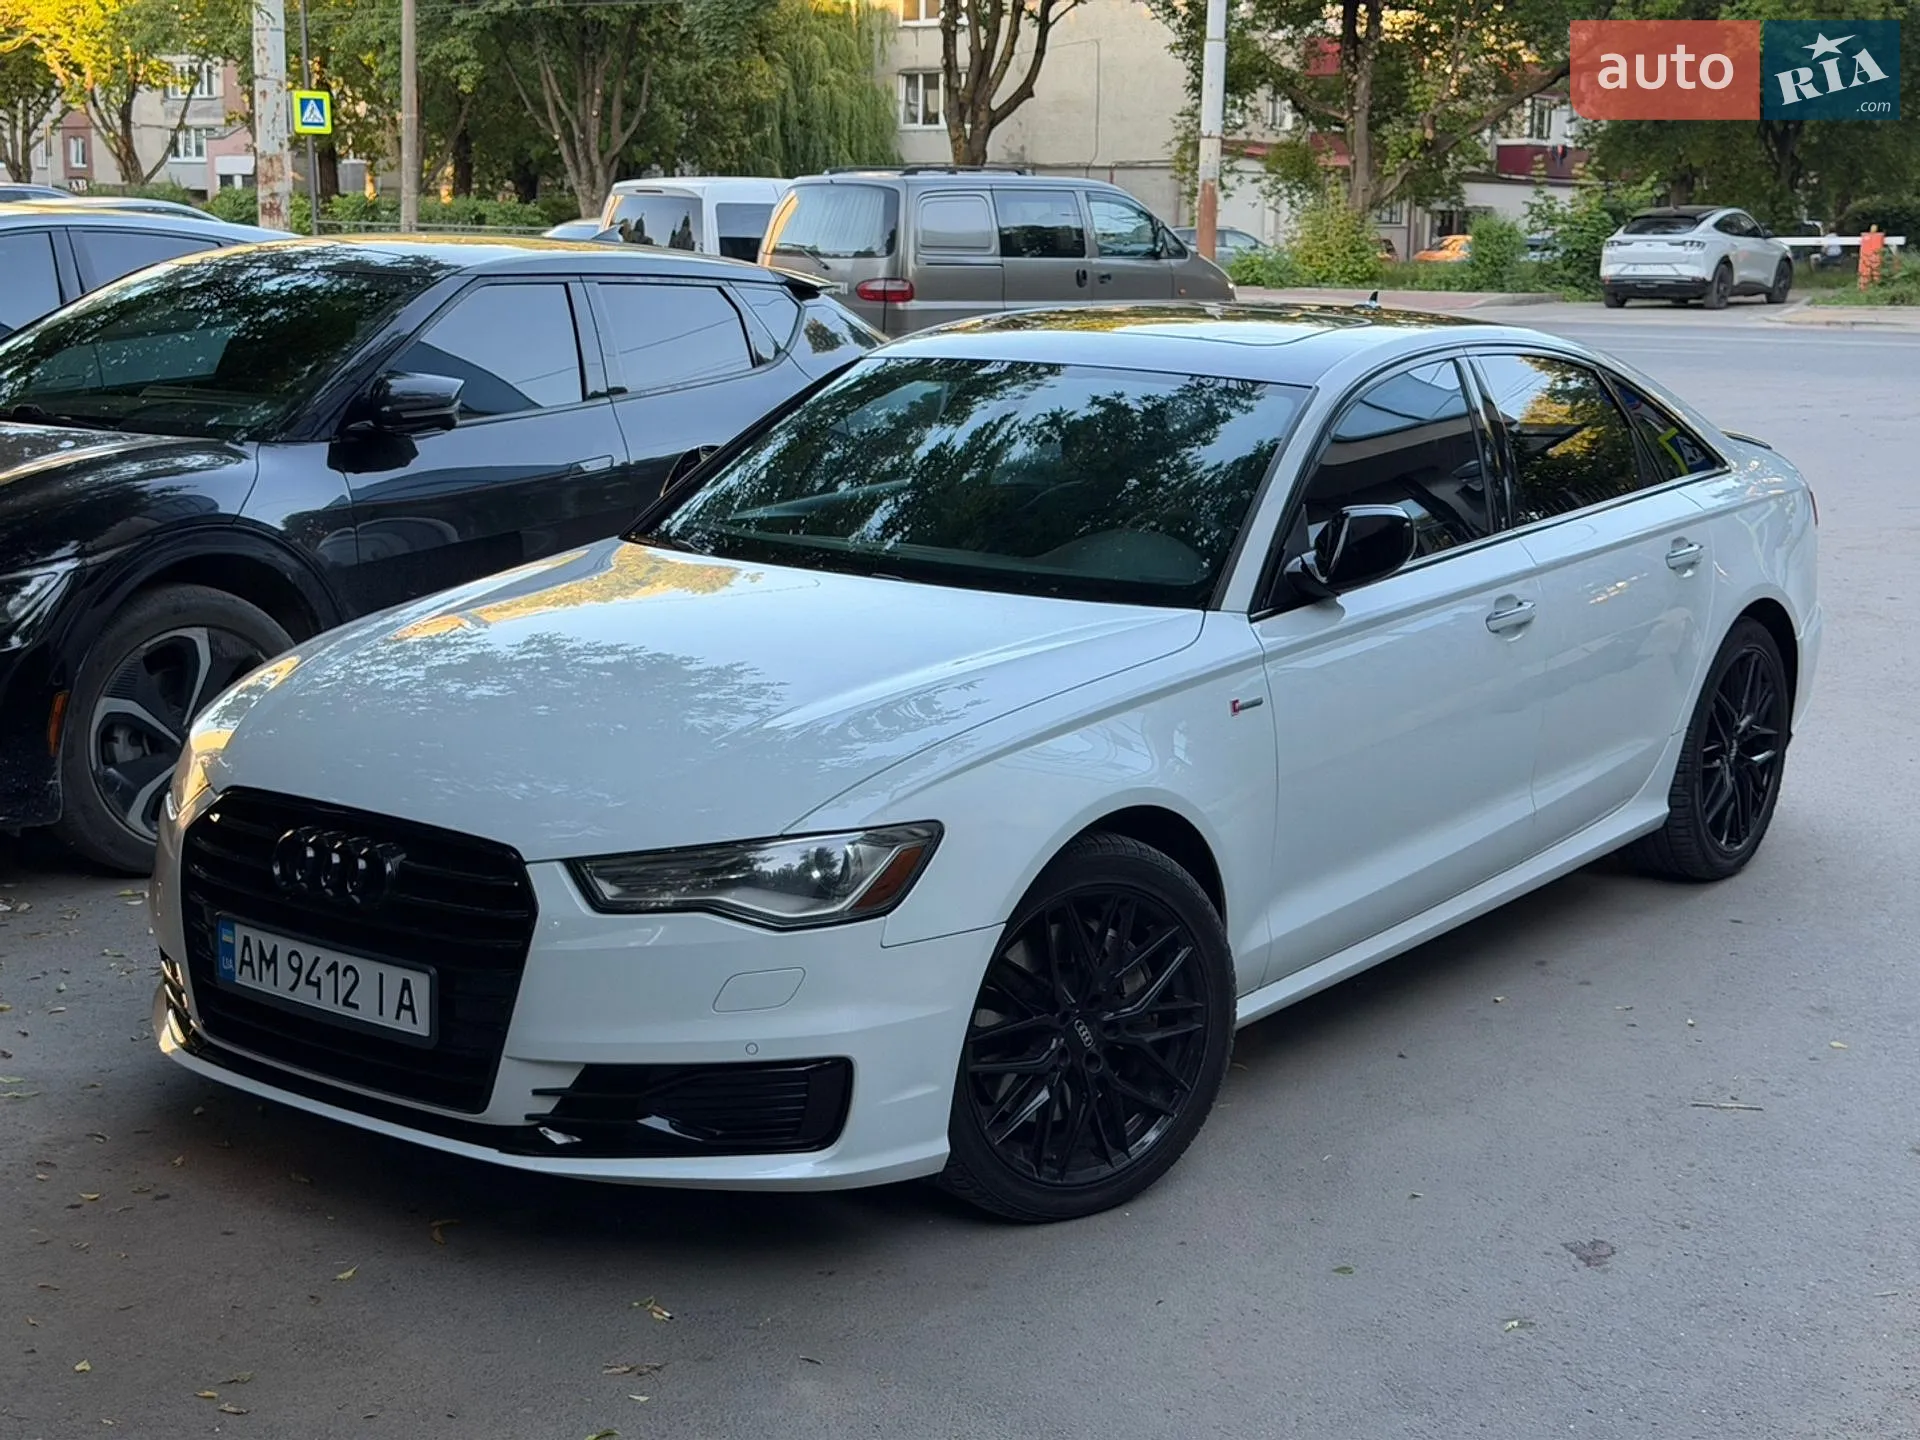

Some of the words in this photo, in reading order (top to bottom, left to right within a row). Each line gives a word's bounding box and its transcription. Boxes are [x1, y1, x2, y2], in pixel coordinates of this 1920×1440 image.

[238, 935, 278, 987] AM
[287, 950, 360, 1011] 9412
[378, 972, 418, 1025] IA
